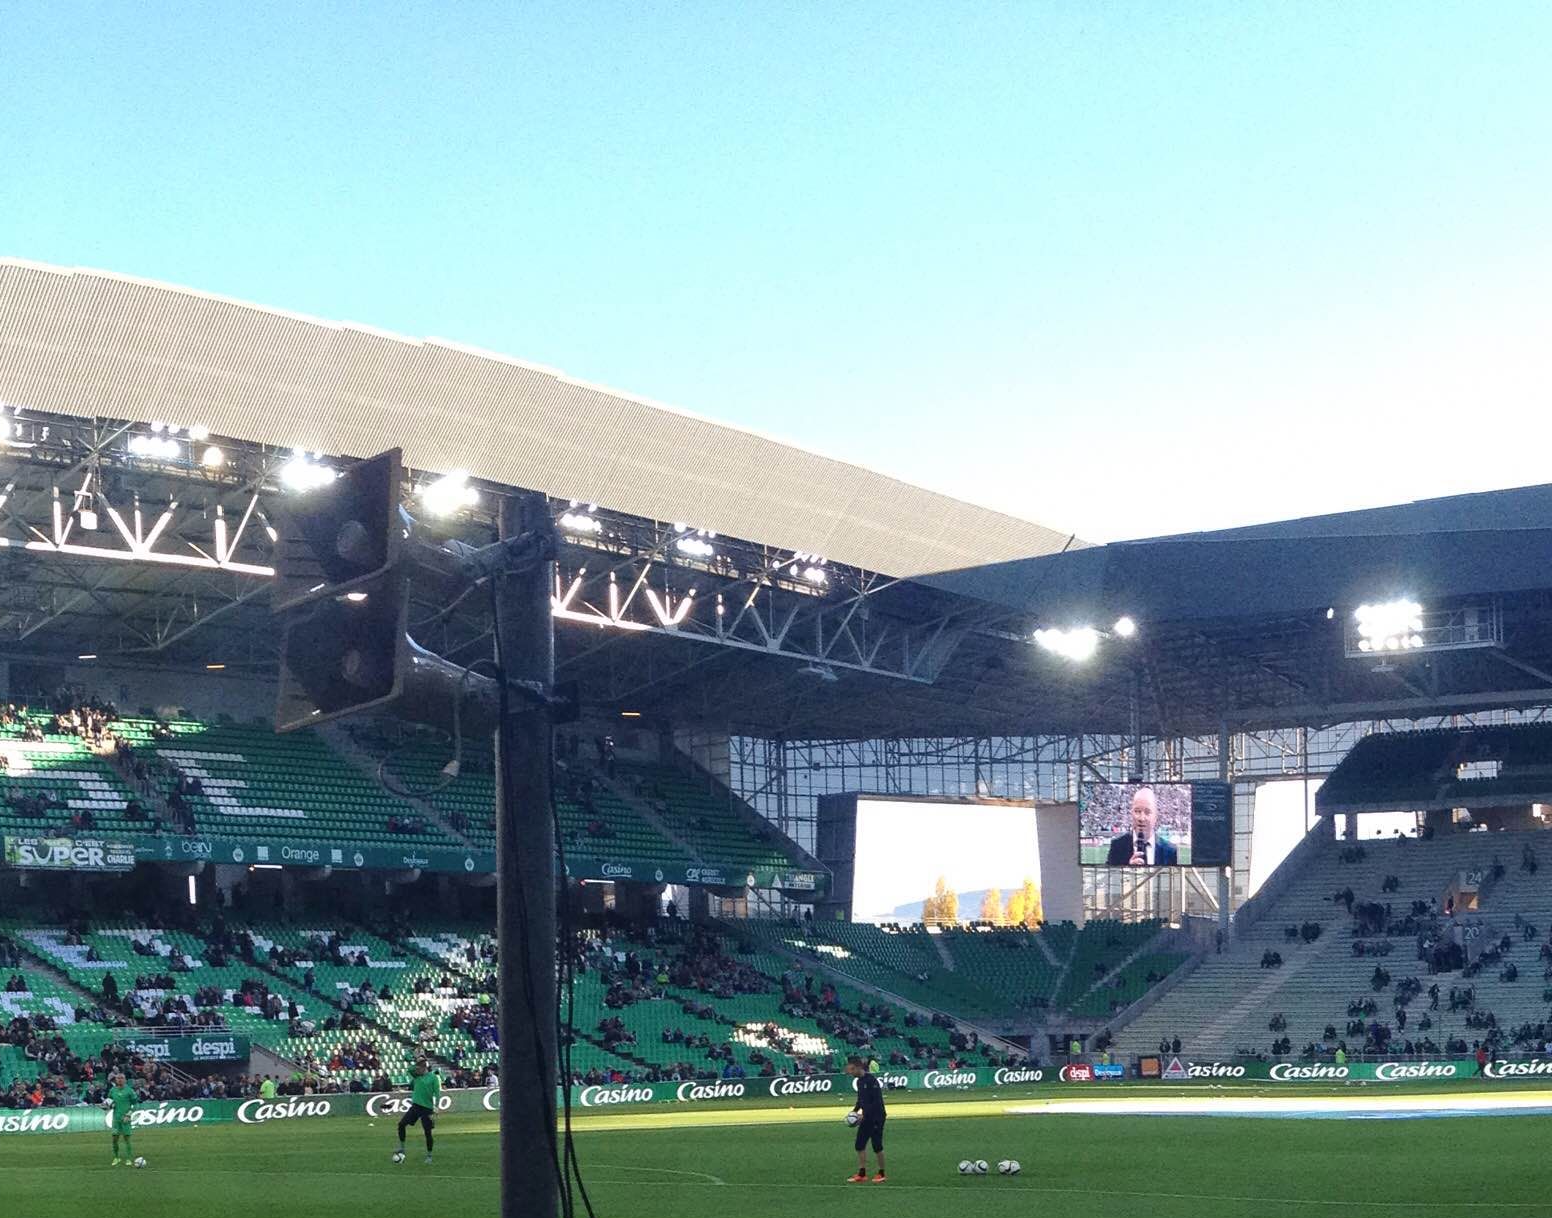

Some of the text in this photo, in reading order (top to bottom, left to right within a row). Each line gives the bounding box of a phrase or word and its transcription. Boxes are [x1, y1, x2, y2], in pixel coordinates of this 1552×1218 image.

[282, 847, 319, 863] Orange
[601, 863, 632, 875] Casino
[192, 1038, 236, 1059] despi
[924, 1069, 976, 1089] Casino
[995, 1066, 1042, 1085] Casino
[1270, 1063, 1348, 1080] Casino
[1375, 1062, 1456, 1080] Casino
[580, 1083, 653, 1107] Casino
[677, 1080, 745, 1102] Casino
[770, 1075, 831, 1096] Casino
[237, 1099, 330, 1124] Casino
